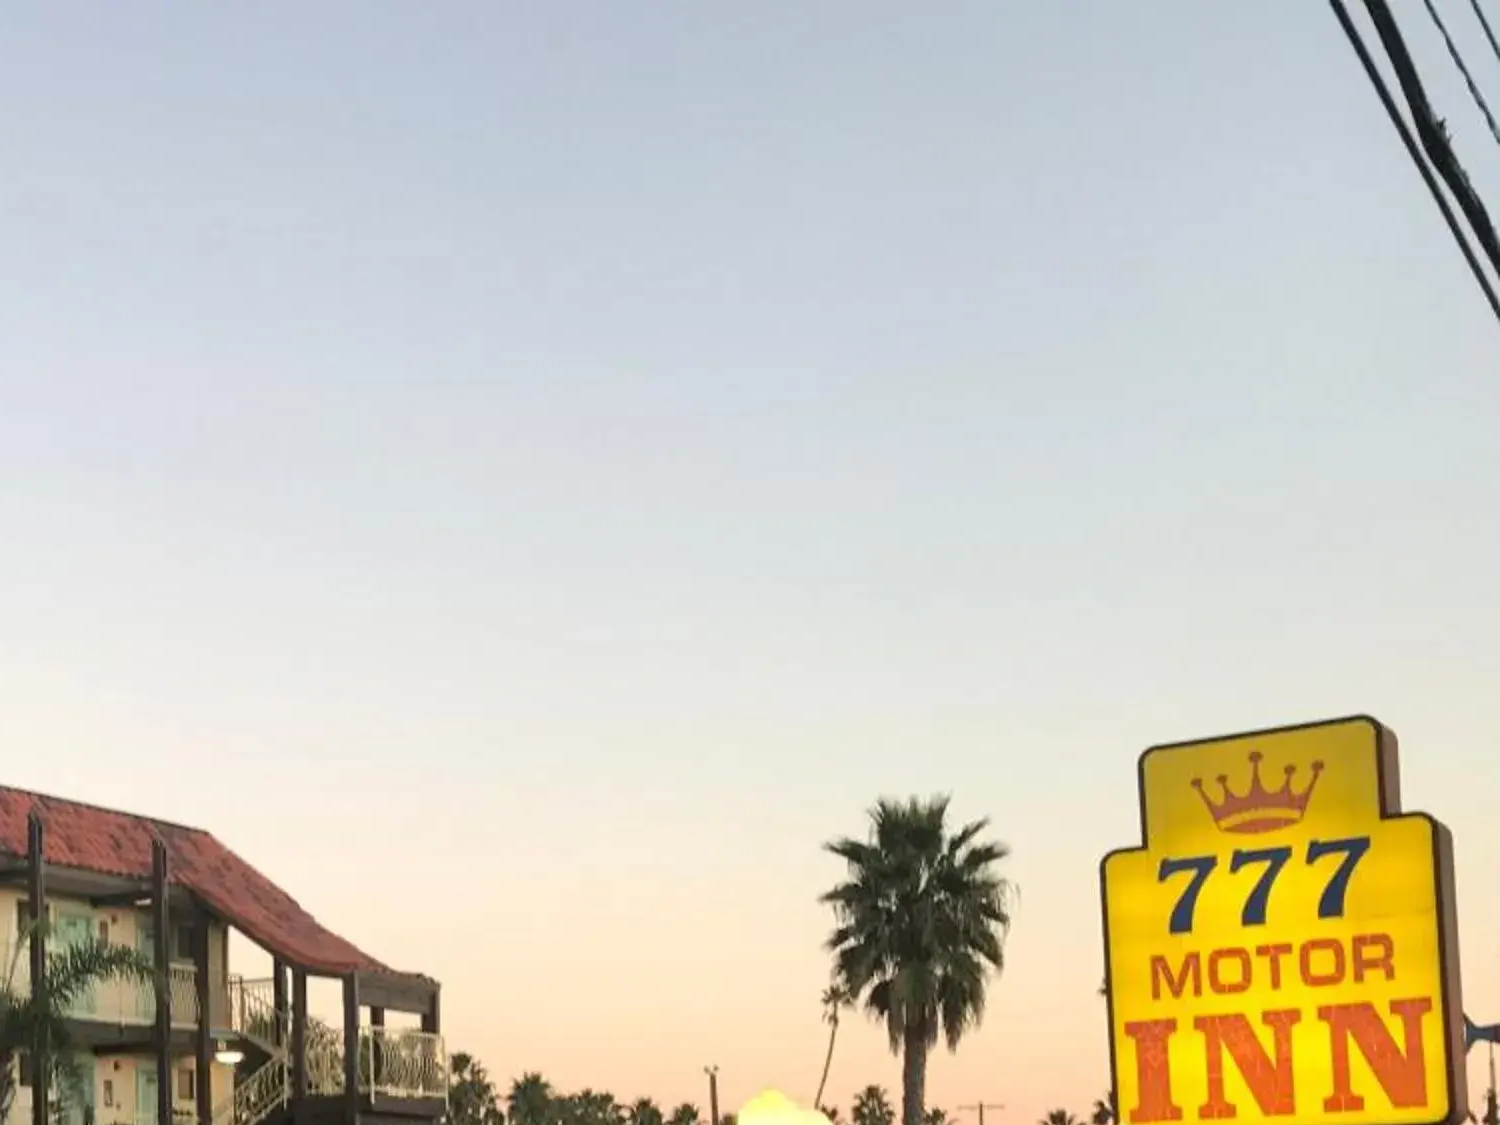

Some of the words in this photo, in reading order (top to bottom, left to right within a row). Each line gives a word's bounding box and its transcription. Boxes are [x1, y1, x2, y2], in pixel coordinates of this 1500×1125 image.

[1158, 836, 1371, 936] 777
[1150, 933, 1395, 1001] MOTOR
[1123, 996, 1432, 1123] INN
